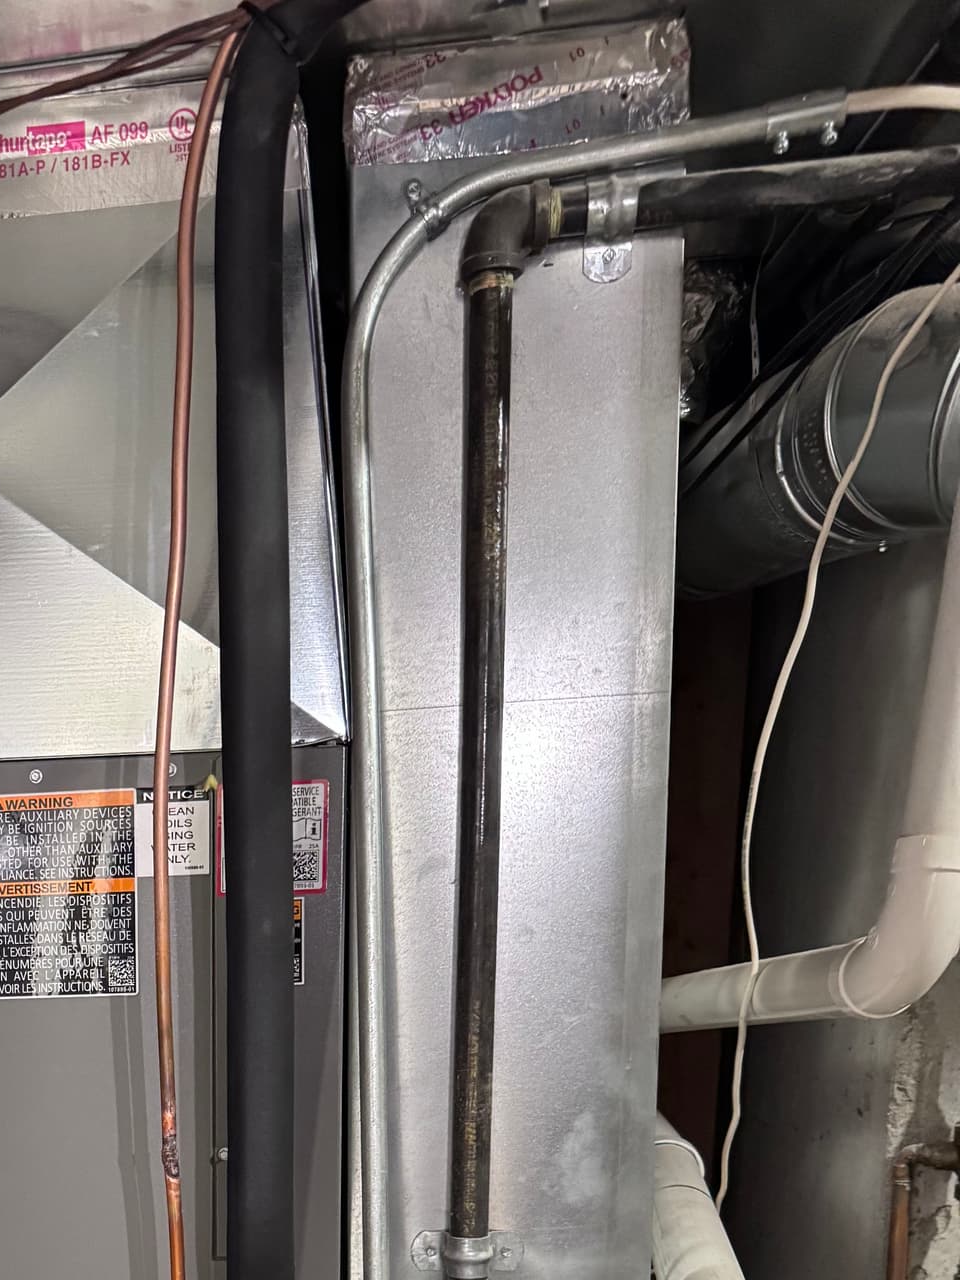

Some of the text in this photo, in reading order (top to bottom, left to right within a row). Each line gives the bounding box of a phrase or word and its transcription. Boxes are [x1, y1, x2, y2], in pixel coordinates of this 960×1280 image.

[91, 124, 114, 144] AF
[118, 121, 149, 142] 099
[169, 143, 192, 154] LIST
[51, 158, 56, 174] /
[63, 151, 131, 175] 181B-FX
[143, 790, 204, 800] NTICE
[292, 786, 319, 797] SERVICE
[5, 797, 73, 810] WARNING
[293, 797, 316, 807] ATIBLE
[20, 809, 79, 822] AUXILIARY
[83, 807, 132, 819] DEVICES
[293, 807, 322, 817] GERANT
[8, 824, 20, 834] BE
[25, 821, 73, 833] IGNITION
[80, 818, 131, 832] SOURCES
[6, 836, 18, 846] BE
[27, 833, 86, 845] INSTALLED
[91, 832, 103, 842] IN
[112, 831, 131, 841] THE
[8, 846, 42, 857] OTHER
[46, 845, 75, 856] THAN
[79, 842, 133, 855] AUXILIARY
[28, 857, 49, 867] FOR
[52, 856, 71, 867] USE
[76, 855, 107, 866] WITH
[114, 854, 133, 864] THE
[40, 869, 56, 880] SEE
[59, 866, 134, 879] INSTRUCTIONS.
